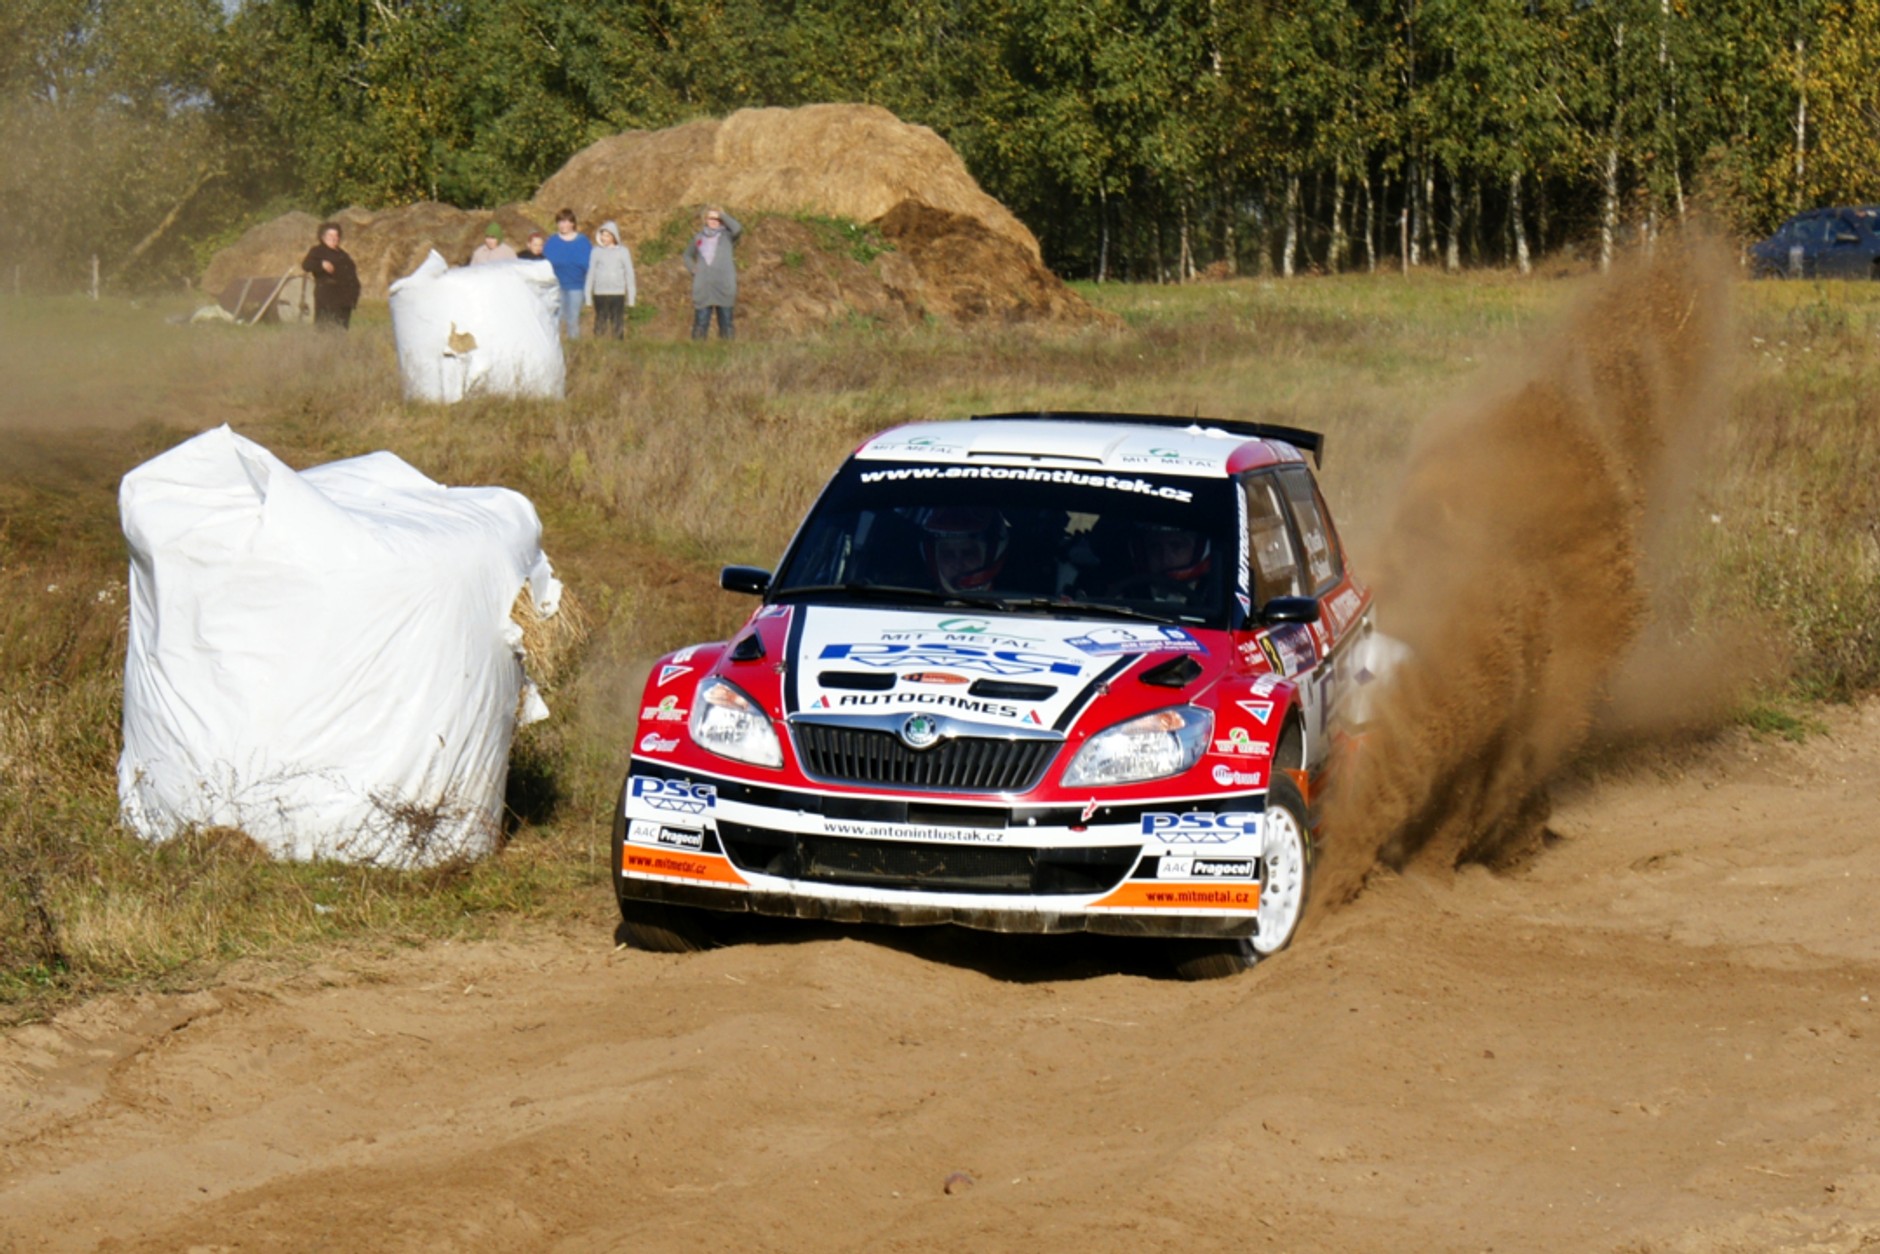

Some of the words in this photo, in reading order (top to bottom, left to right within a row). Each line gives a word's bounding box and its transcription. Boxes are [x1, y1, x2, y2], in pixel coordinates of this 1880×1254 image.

[1161, 458, 1217, 469] METAL
[860, 466, 1194, 503] www.antonintlustak.cz
[880, 633, 927, 641] MIT
[944, 633, 1037, 649] METAL
[839, 693, 1018, 718] AUTOGAMES
[633, 826, 656, 838] AAC
[823, 821, 1004, 843] www.antonintlustak.cz
[628, 855, 707, 875] www.mitmetal.cz
[1162, 863, 1189, 873] AAC
[1193, 861, 1251, 877] Pragocel
[1145, 890, 1249, 903] www.mitmetal.cz
